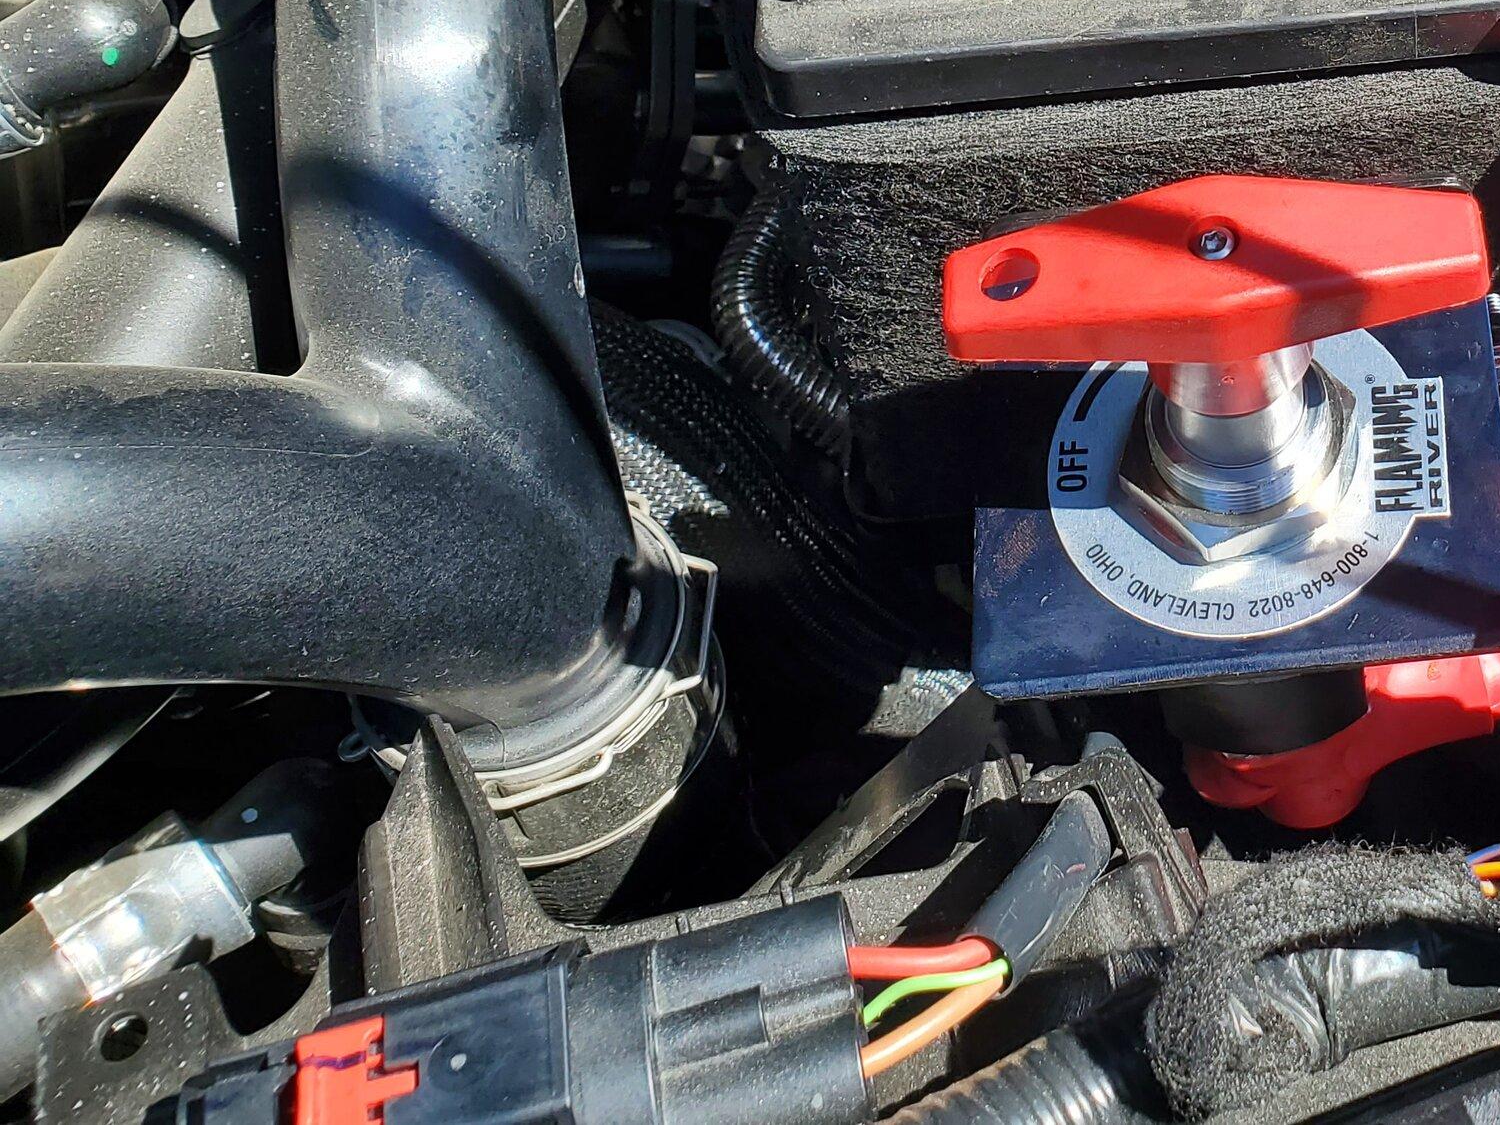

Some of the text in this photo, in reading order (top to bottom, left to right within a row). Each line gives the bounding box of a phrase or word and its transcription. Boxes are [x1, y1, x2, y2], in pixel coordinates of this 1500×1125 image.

[1056, 440, 1089, 492] OFF
[1371, 383, 1424, 513] FLAMING
[1424, 382, 1444, 508] RIVER
[1086, 543, 1124, 582] OHIO
[1249, 530, 1380, 619] 1-800-648-8022
